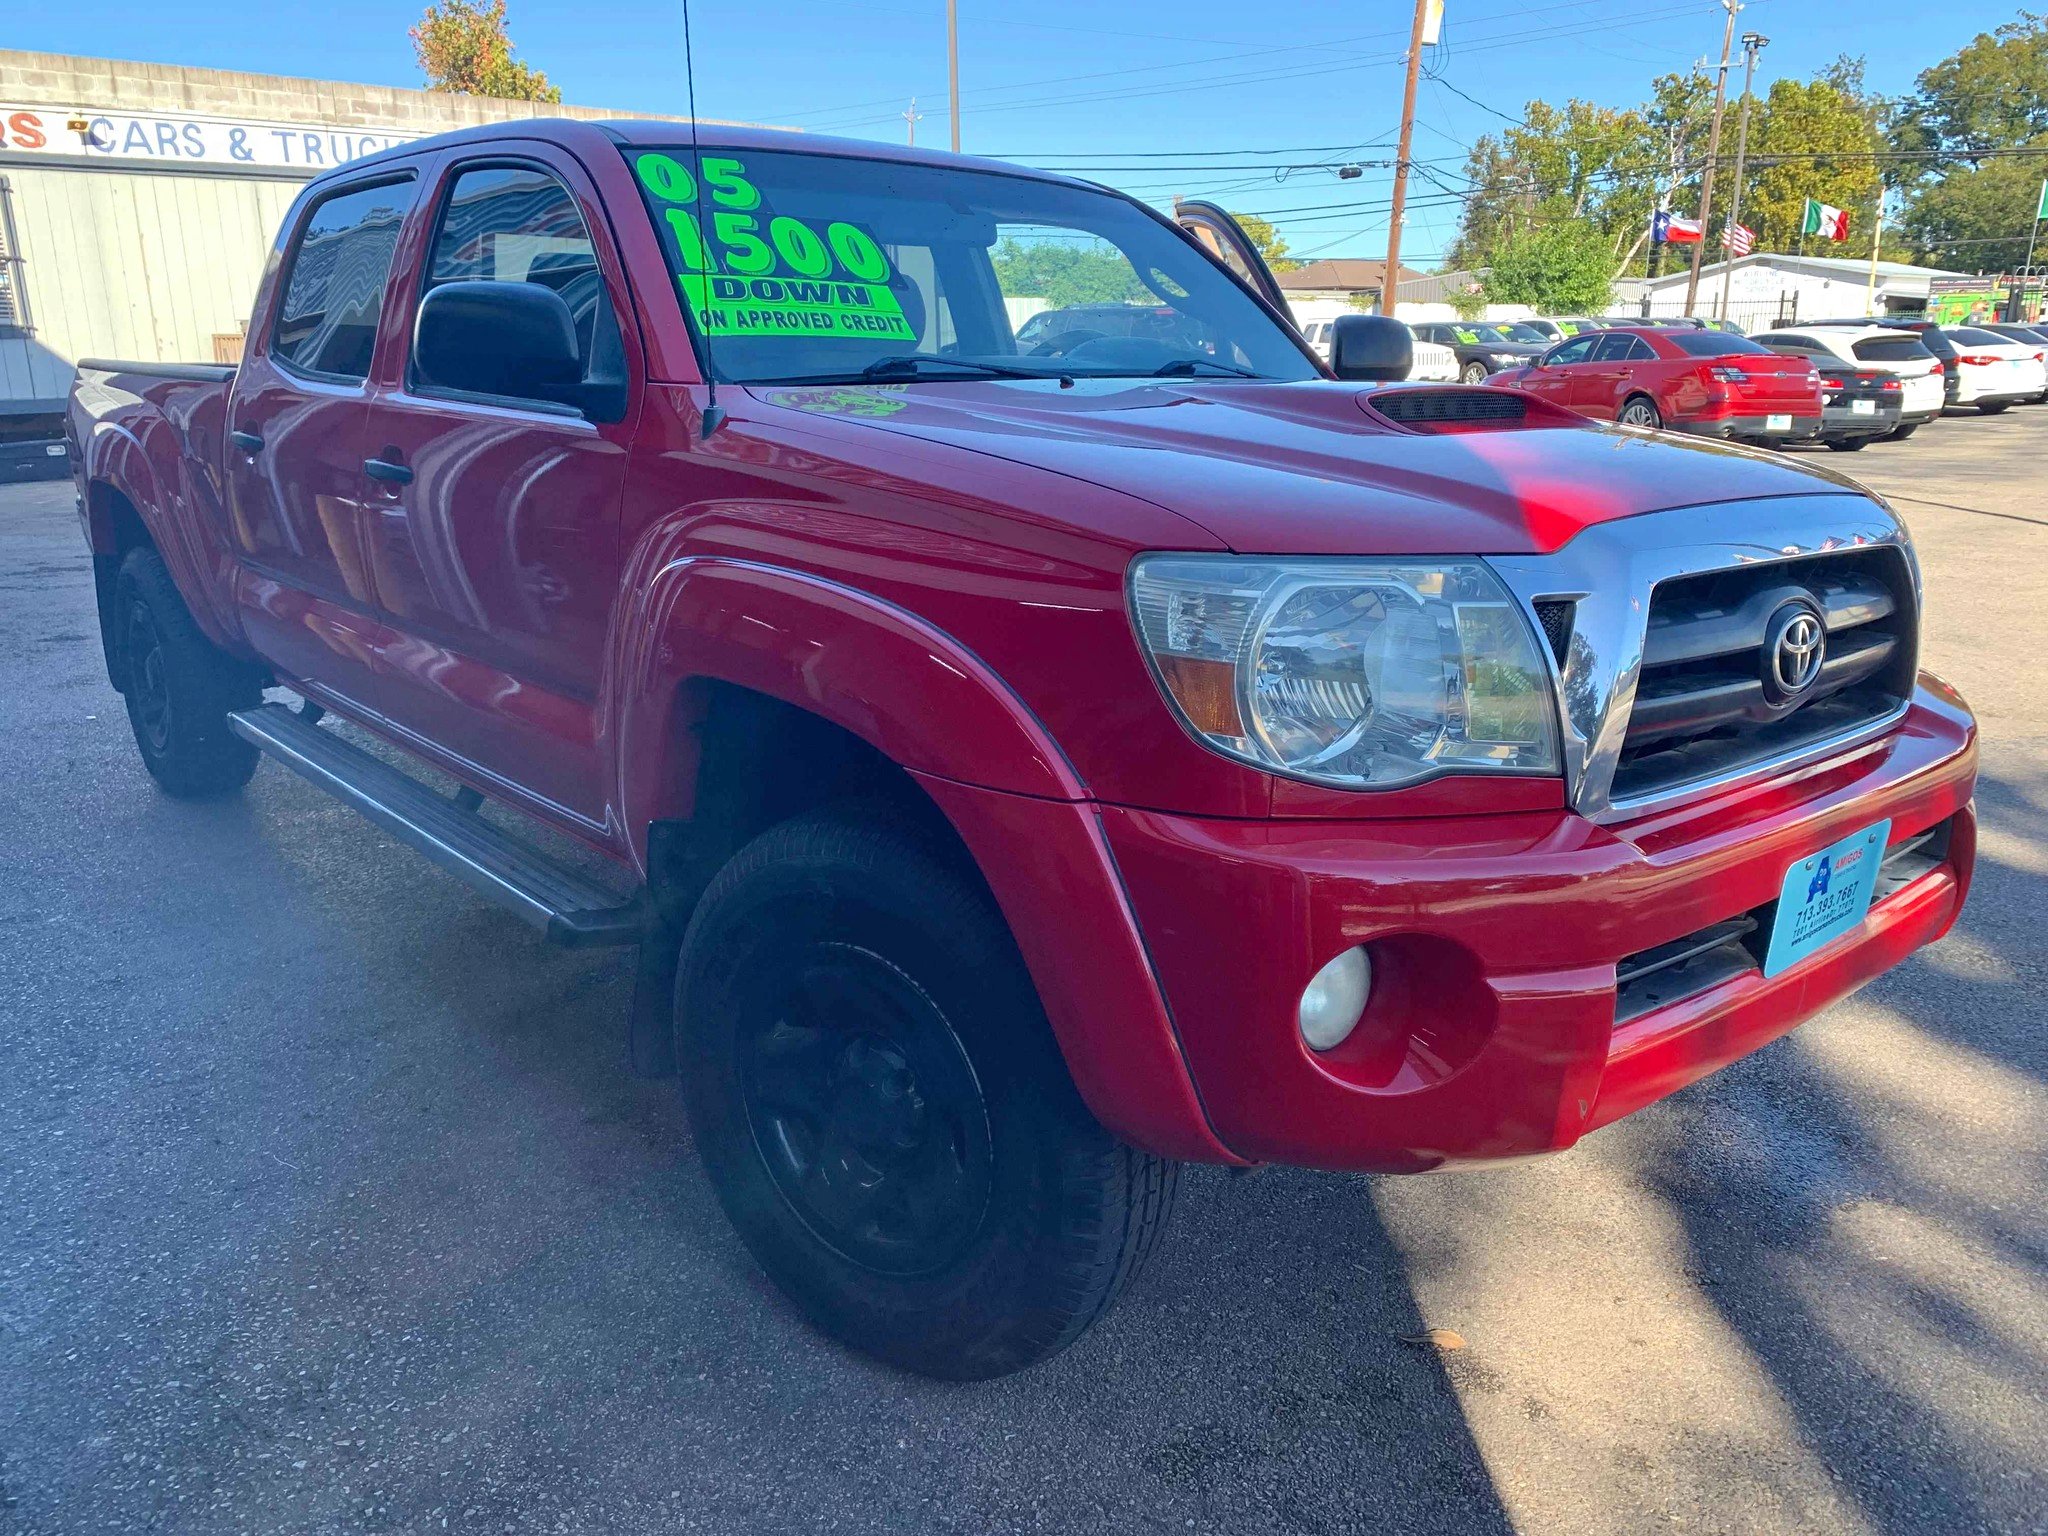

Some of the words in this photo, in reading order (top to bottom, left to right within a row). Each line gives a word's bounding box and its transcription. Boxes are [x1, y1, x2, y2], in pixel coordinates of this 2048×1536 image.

[0, 112, 46, 149] S
[89, 117, 206, 158] CARS
[229, 128, 255, 161] &
[637, 153, 761, 211] 05
[665, 208, 890, 283] 1500
[712, 278, 876, 308] DOWN
[700, 309, 728, 330] ON
[736, 311, 834, 331] APPROVED
[842, 314, 907, 334] CREDIT
[1796, 881, 1860, 928] 713.393.7667
